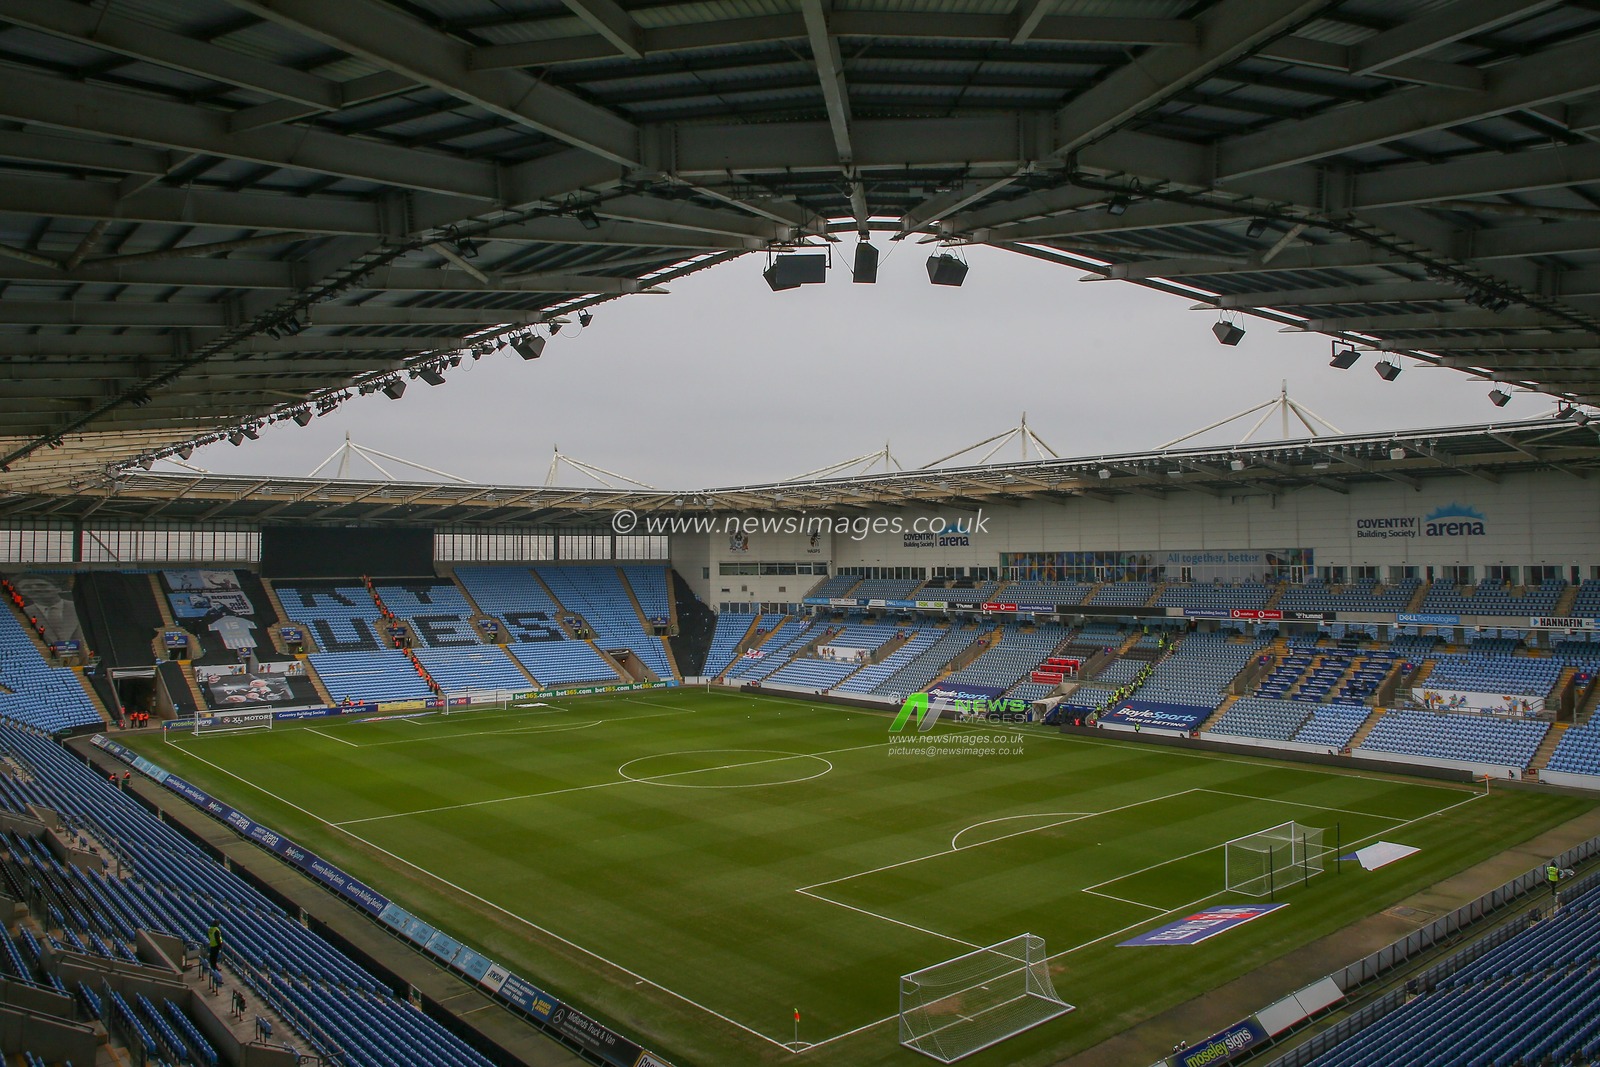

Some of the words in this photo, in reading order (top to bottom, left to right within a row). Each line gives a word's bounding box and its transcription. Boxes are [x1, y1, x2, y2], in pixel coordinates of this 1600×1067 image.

[1357, 517, 1415, 529] COVENTRY
[1426, 521, 1486, 536] arena
[903, 533, 935, 541] COVENTRY
[1357, 530, 1387, 539] Building
[1389, 529, 1416, 538] Society
[939, 536, 970, 547] arena
[1168, 553, 1180, 563] All
[1182, 552, 1225, 565] together,
[1227, 551, 1260, 563] better
[1399, 614, 1417, 622] DELL
[1416, 615, 1458, 625] Technologies
[1540, 618, 1583, 627] HANNAFIN
[595, 685, 630, 693] bet365.com
[633, 682, 666, 690] bet365.com
[515, 691, 553, 700] bet365.com
[556, 688, 592, 697] bet365.com
[1117, 707, 1198, 722] BoyleSports
[311, 861, 324, 874] Coventry
[322, 867, 335, 881] Building
[334, 873, 345, 887] Society
[346, 882, 361, 896] Coventry
[359, 890, 373, 905] Building
[371, 897, 384, 911] Society
[567, 1011, 589, 1029] Midlands
[586, 1022, 600, 1037] Truck
[599, 1030, 605, 1040] &
[605, 1033, 616, 1046] Van
[1186, 1028, 1252, 1067] moseleysigns
